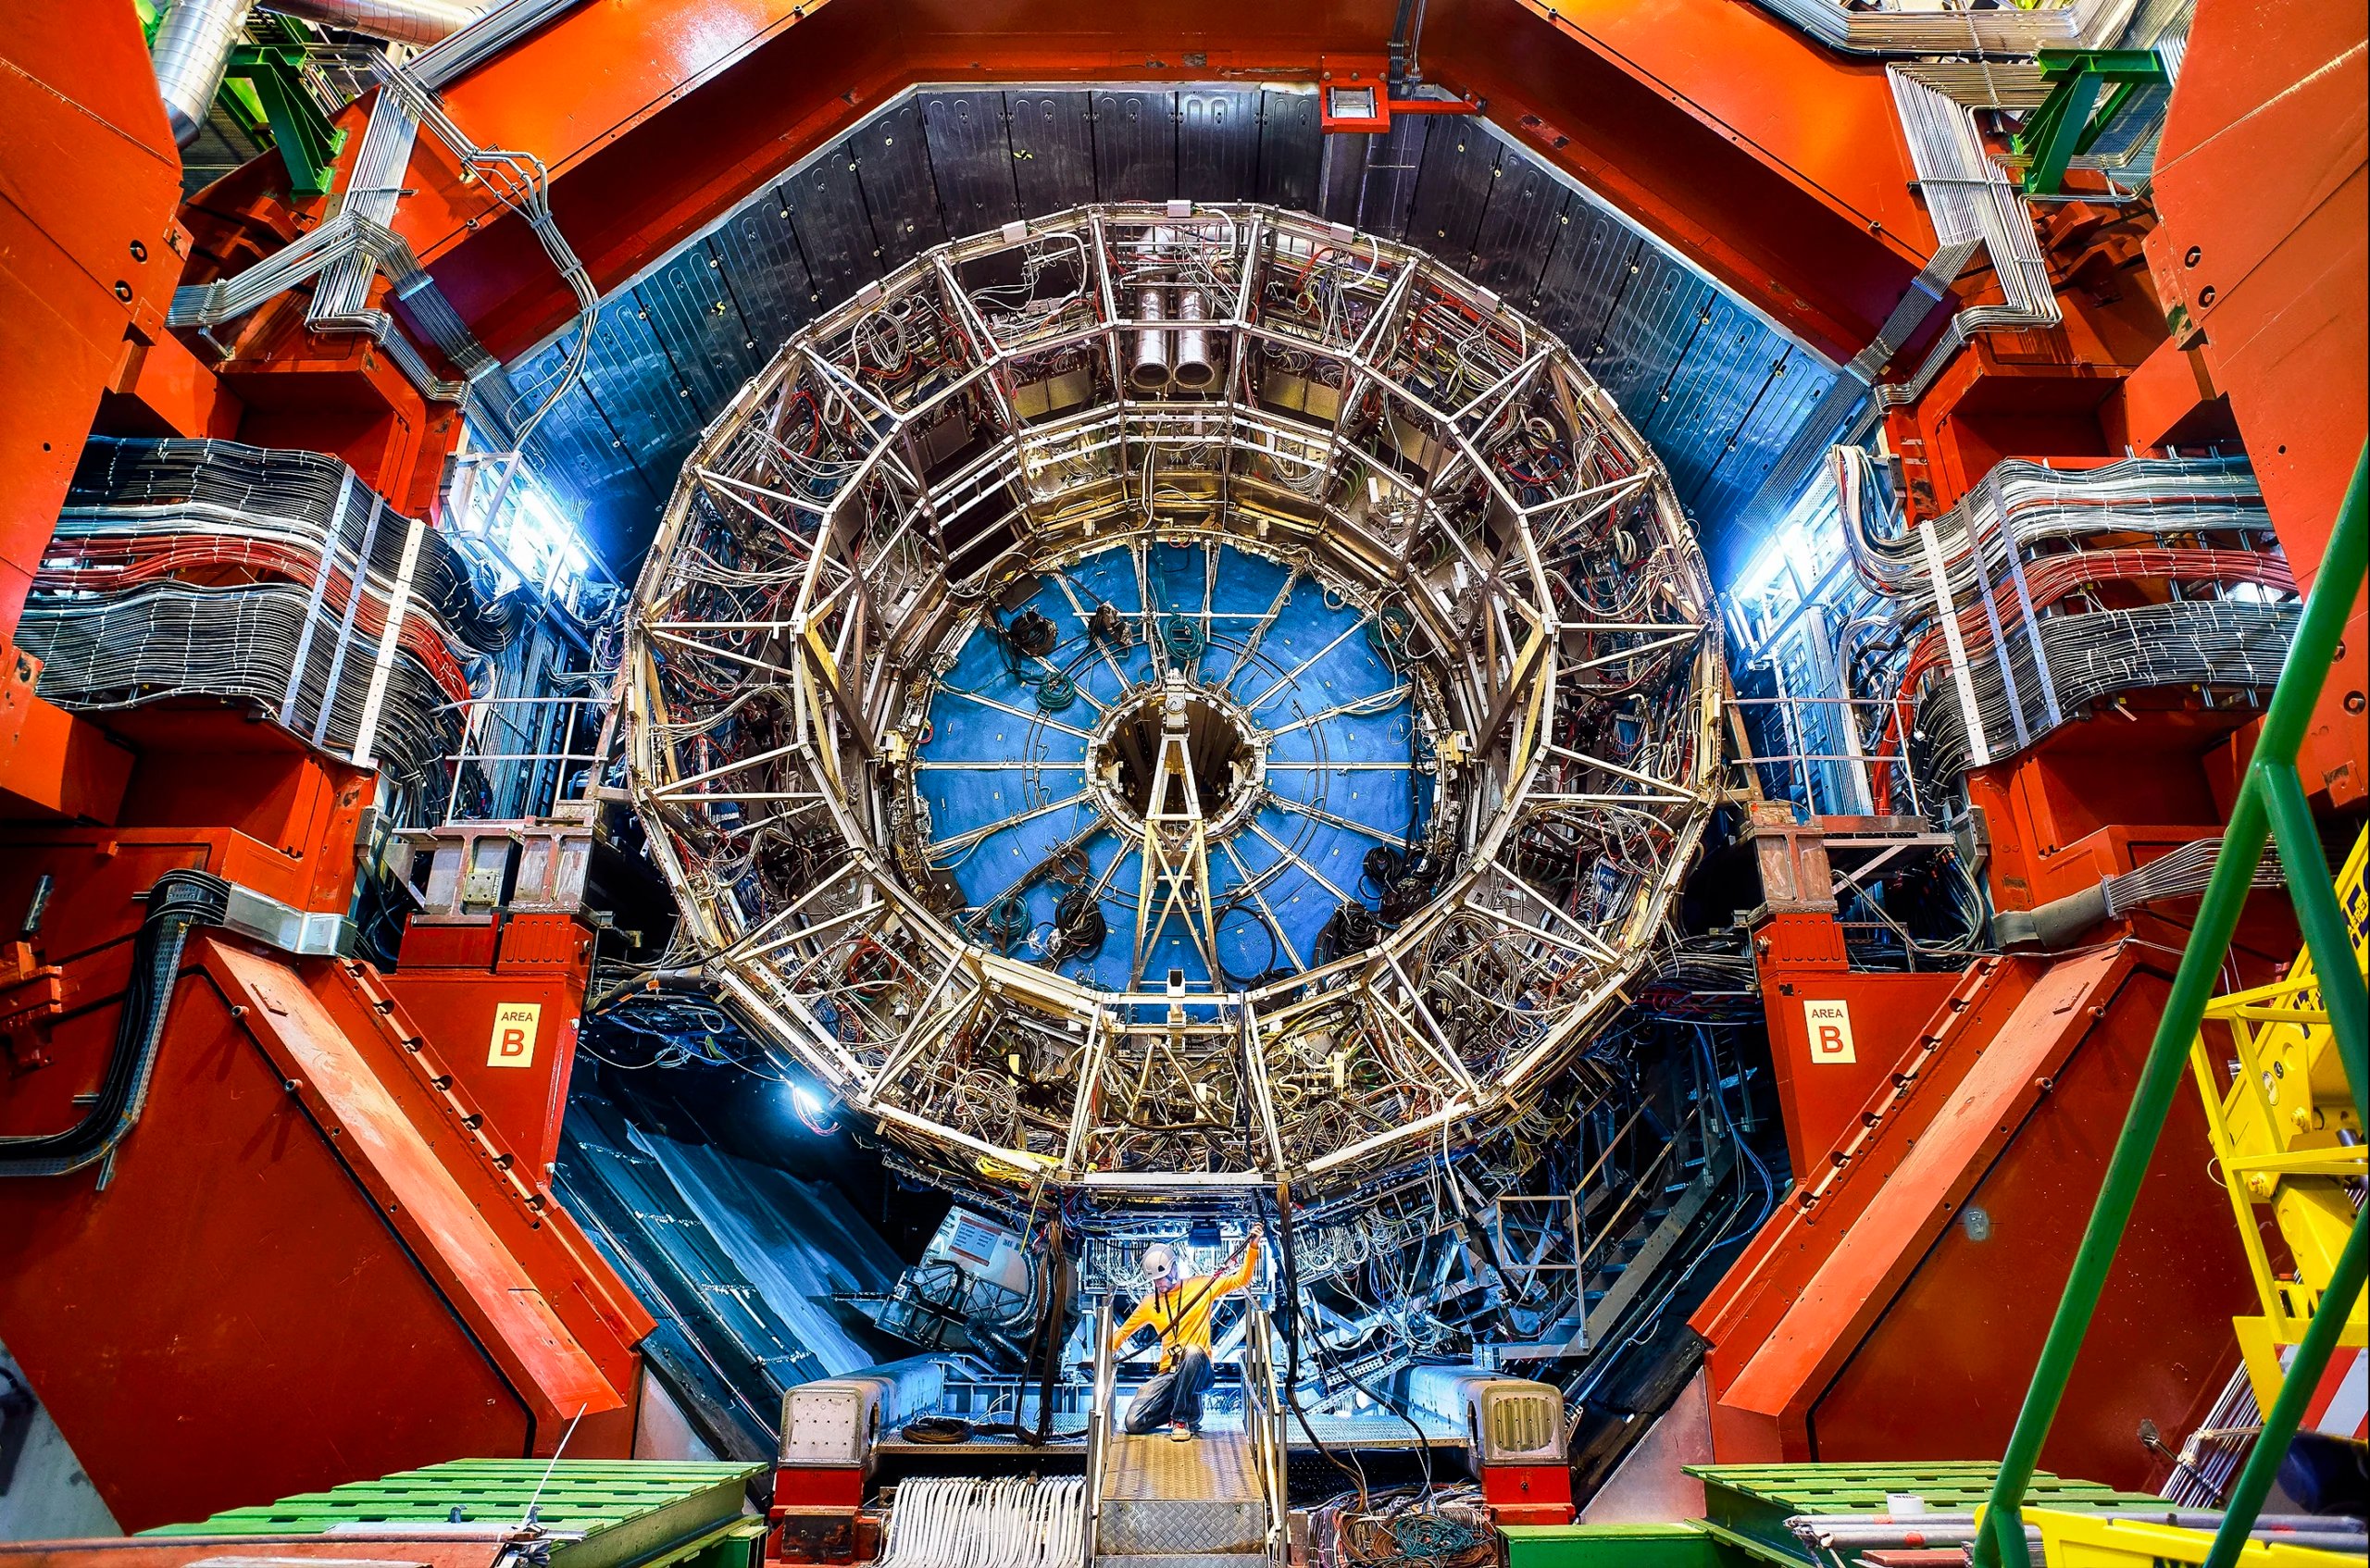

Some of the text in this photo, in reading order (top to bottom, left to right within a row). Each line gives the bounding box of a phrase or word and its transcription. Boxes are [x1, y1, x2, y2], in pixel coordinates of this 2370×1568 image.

[501, 1012, 533, 1022] AREA
[1812, 1008, 1844, 1018] AREA
[501, 1028, 525, 1056] B
[1819, 1026, 1844, 1053] B
